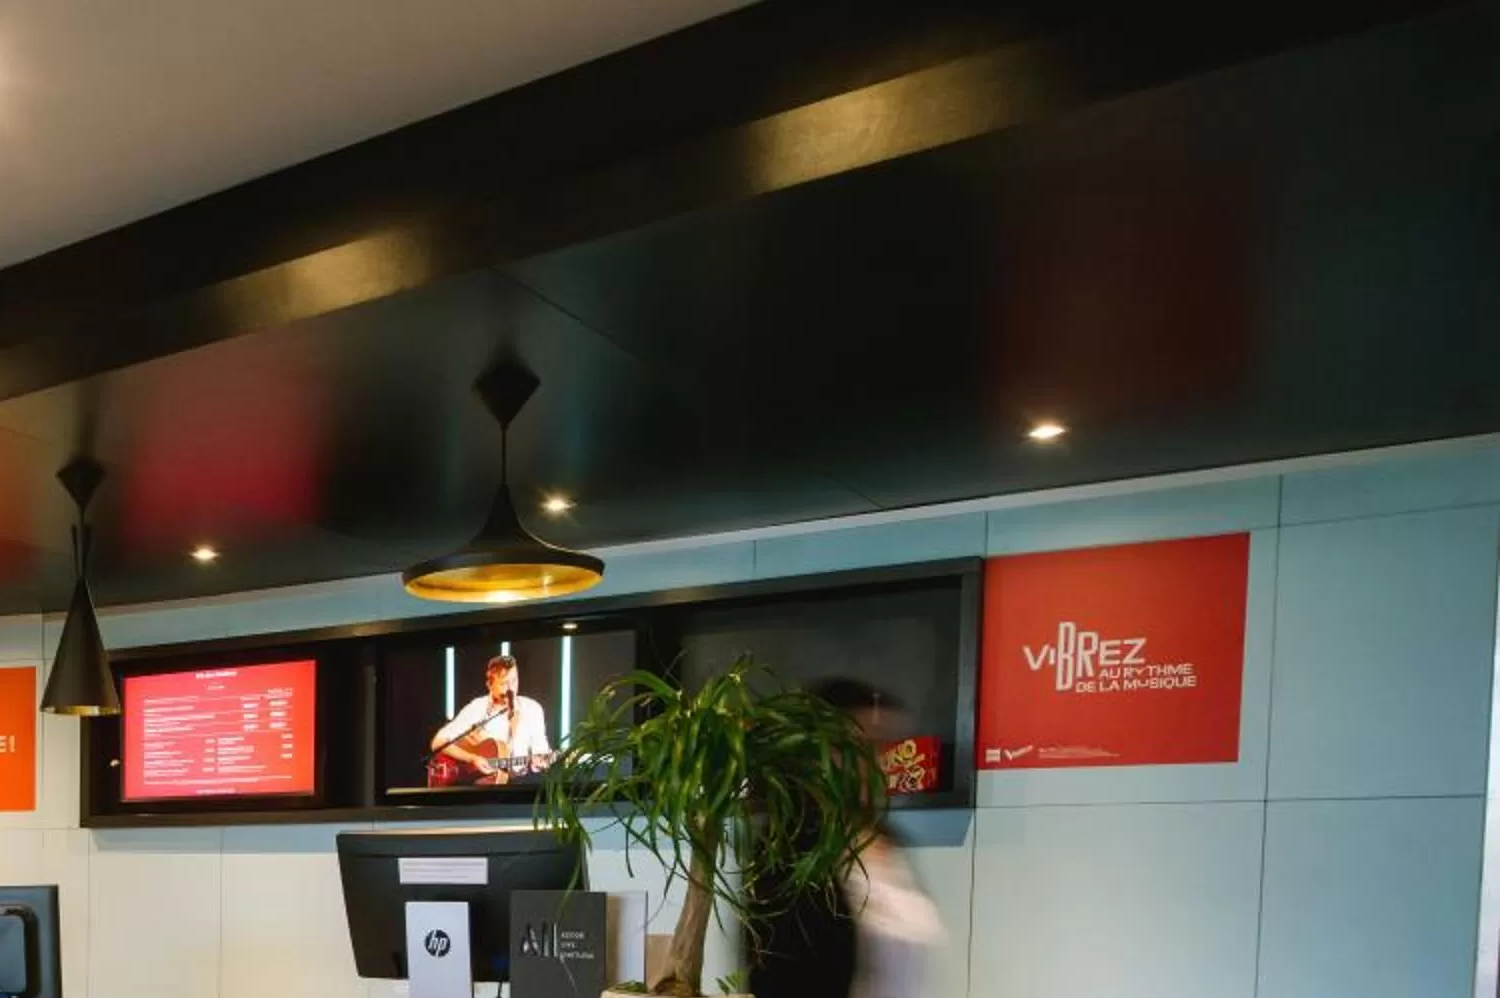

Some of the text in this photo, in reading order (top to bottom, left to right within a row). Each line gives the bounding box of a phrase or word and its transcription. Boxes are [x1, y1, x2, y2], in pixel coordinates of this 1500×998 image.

[1099, 663, 1194, 679] AU RYTHME
[1076, 676, 1197, 693] DE LA MUSIQUE
[426, 930, 450, 957] hp
